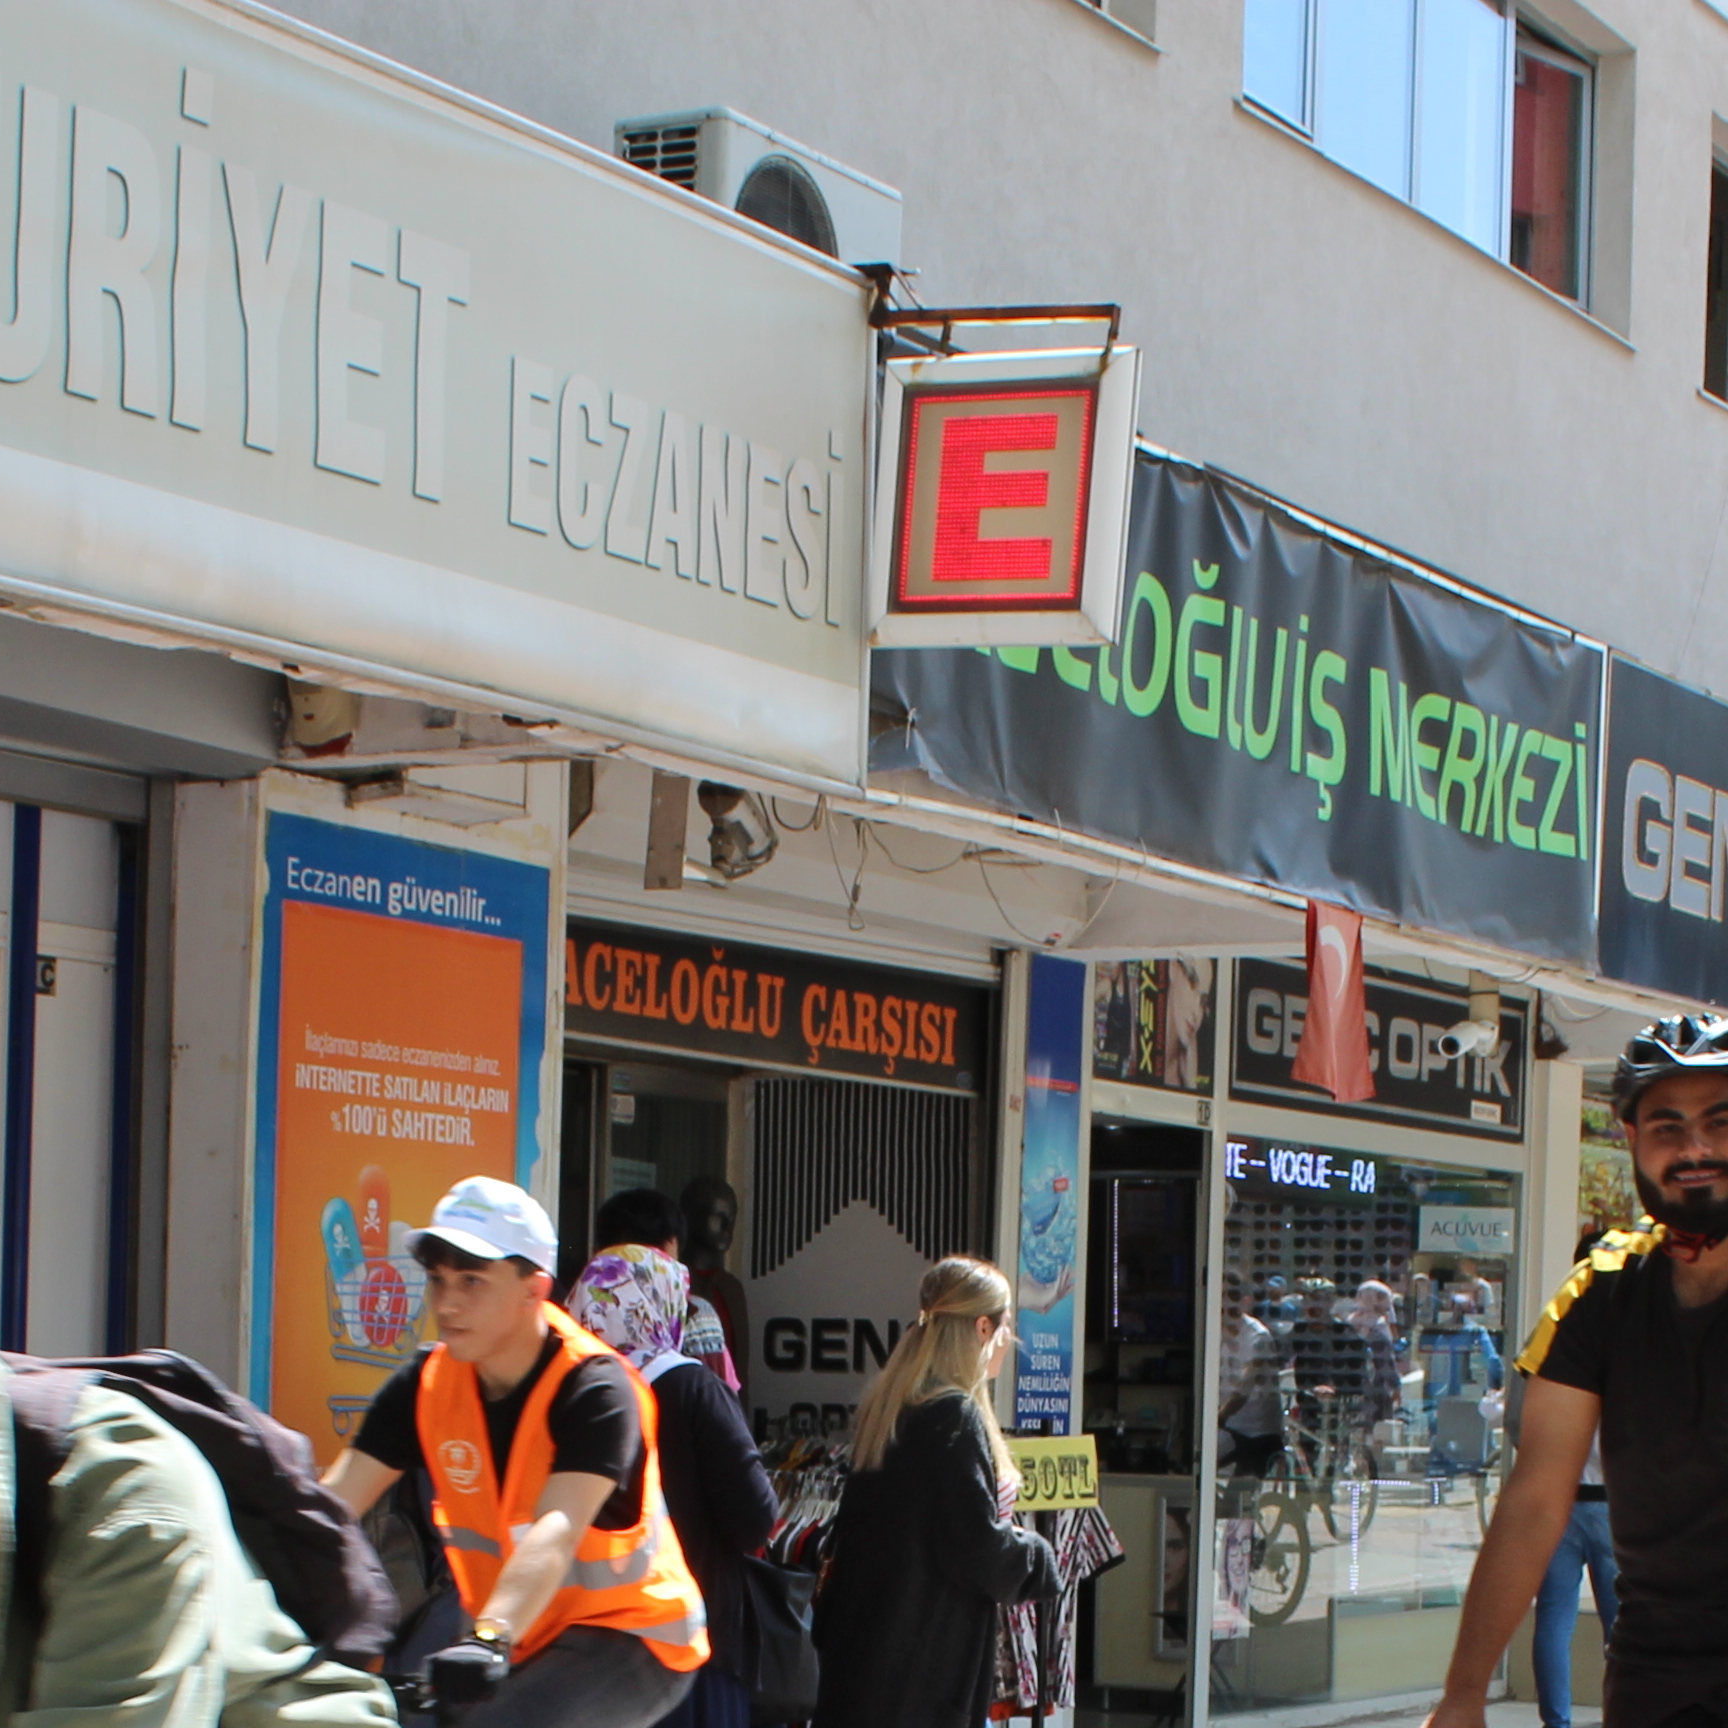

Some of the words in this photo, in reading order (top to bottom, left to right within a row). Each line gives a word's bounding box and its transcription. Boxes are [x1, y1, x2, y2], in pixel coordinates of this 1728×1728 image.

[508, 354, 844, 629] ECZANESİ
[930, 412, 1059, 583] E
[1369, 667, 1588, 861] MERKEZİ
[285, 856, 381, 905] Eczanen
[386, 876, 502, 927] güvenilir...
[360, 1039, 400, 1063] sadece
[800, 983, 959, 1075] ÇARŞISI
[294, 1062, 381, 1098] İNTERNETTE
[383, 1074, 441, 1106] SATILAN
[442, 1081, 511, 1115] İLAÇLARIN
[391, 1109, 476, 1147] SAHTEDİR.
[1430, 1220, 1503, 1238] ACUVUE
[763, 1316, 917, 1374] GEN
[1030, 1350, 1061, 1371] SÜREN
[1032, 1331, 1059, 1350] UZUN
[1017, 1392, 1069, 1413] DÜNYASINI
